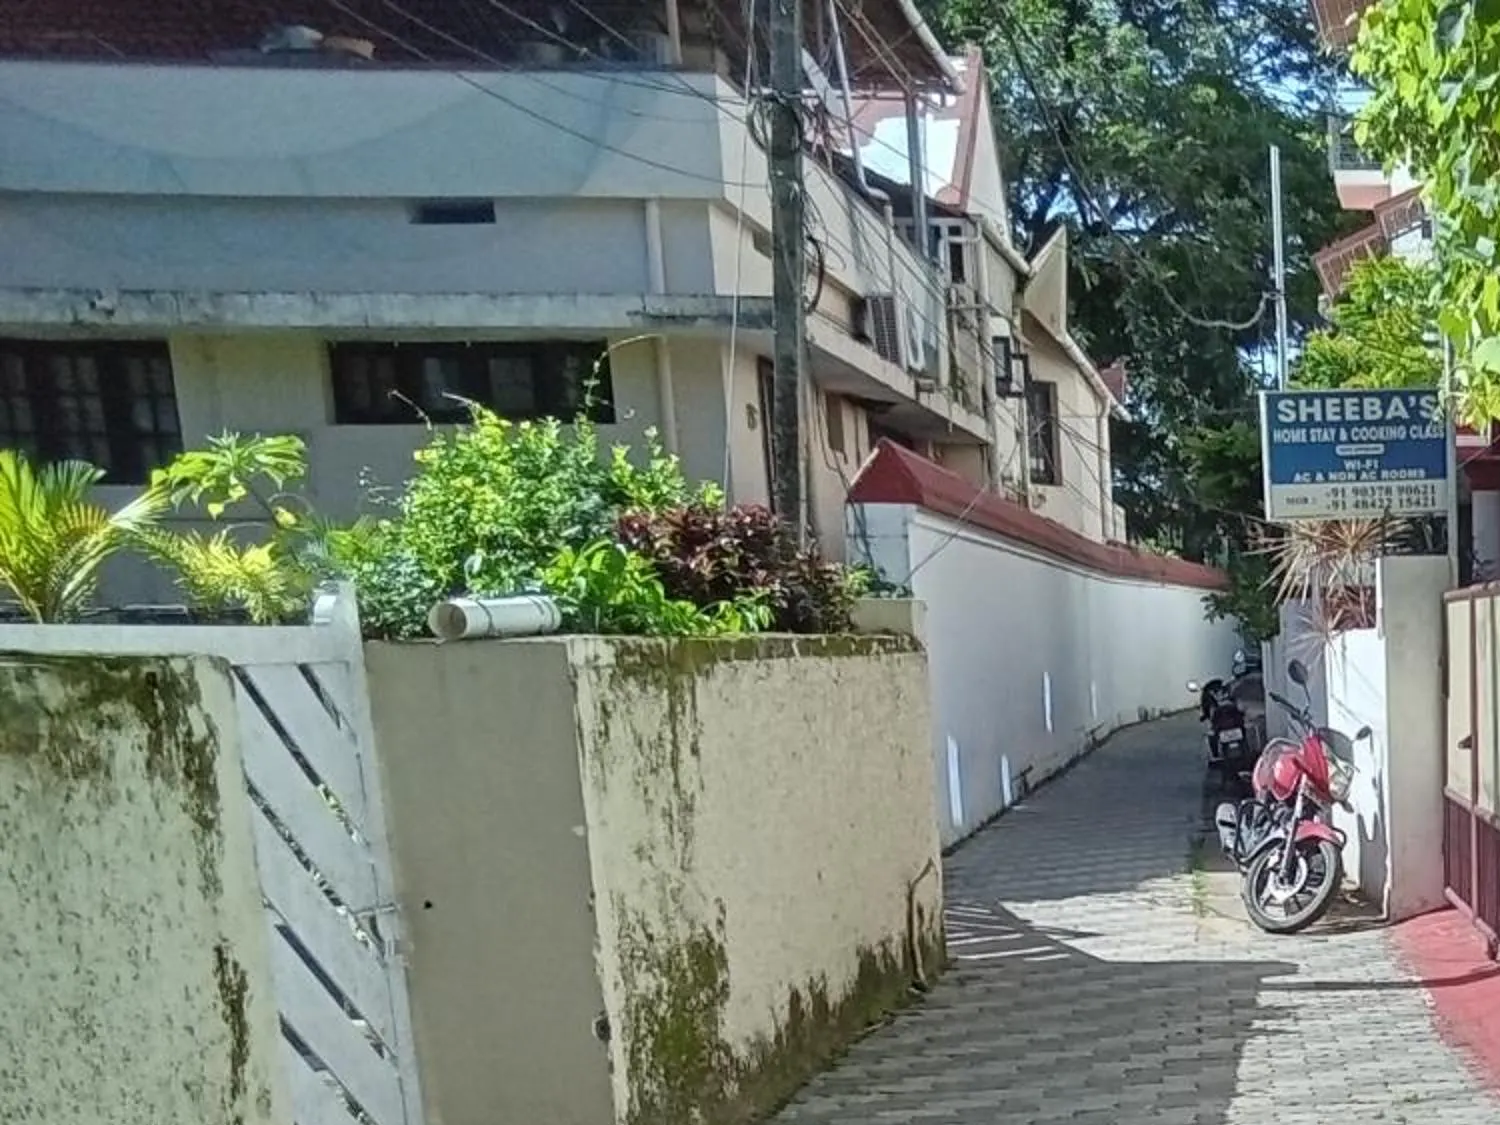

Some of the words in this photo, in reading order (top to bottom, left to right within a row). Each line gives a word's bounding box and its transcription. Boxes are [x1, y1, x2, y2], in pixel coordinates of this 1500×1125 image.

[1277, 396, 1438, 422] SHEEBA'S
[1274, 428, 1307, 443] HOME
[1309, 427, 1336, 442] STAY
[1340, 427, 1349, 442] &
[1351, 425, 1407, 441] COOKING
[1344, 459, 1378, 470] WI-FI
[1381, 469, 1426, 479] ROOMS
